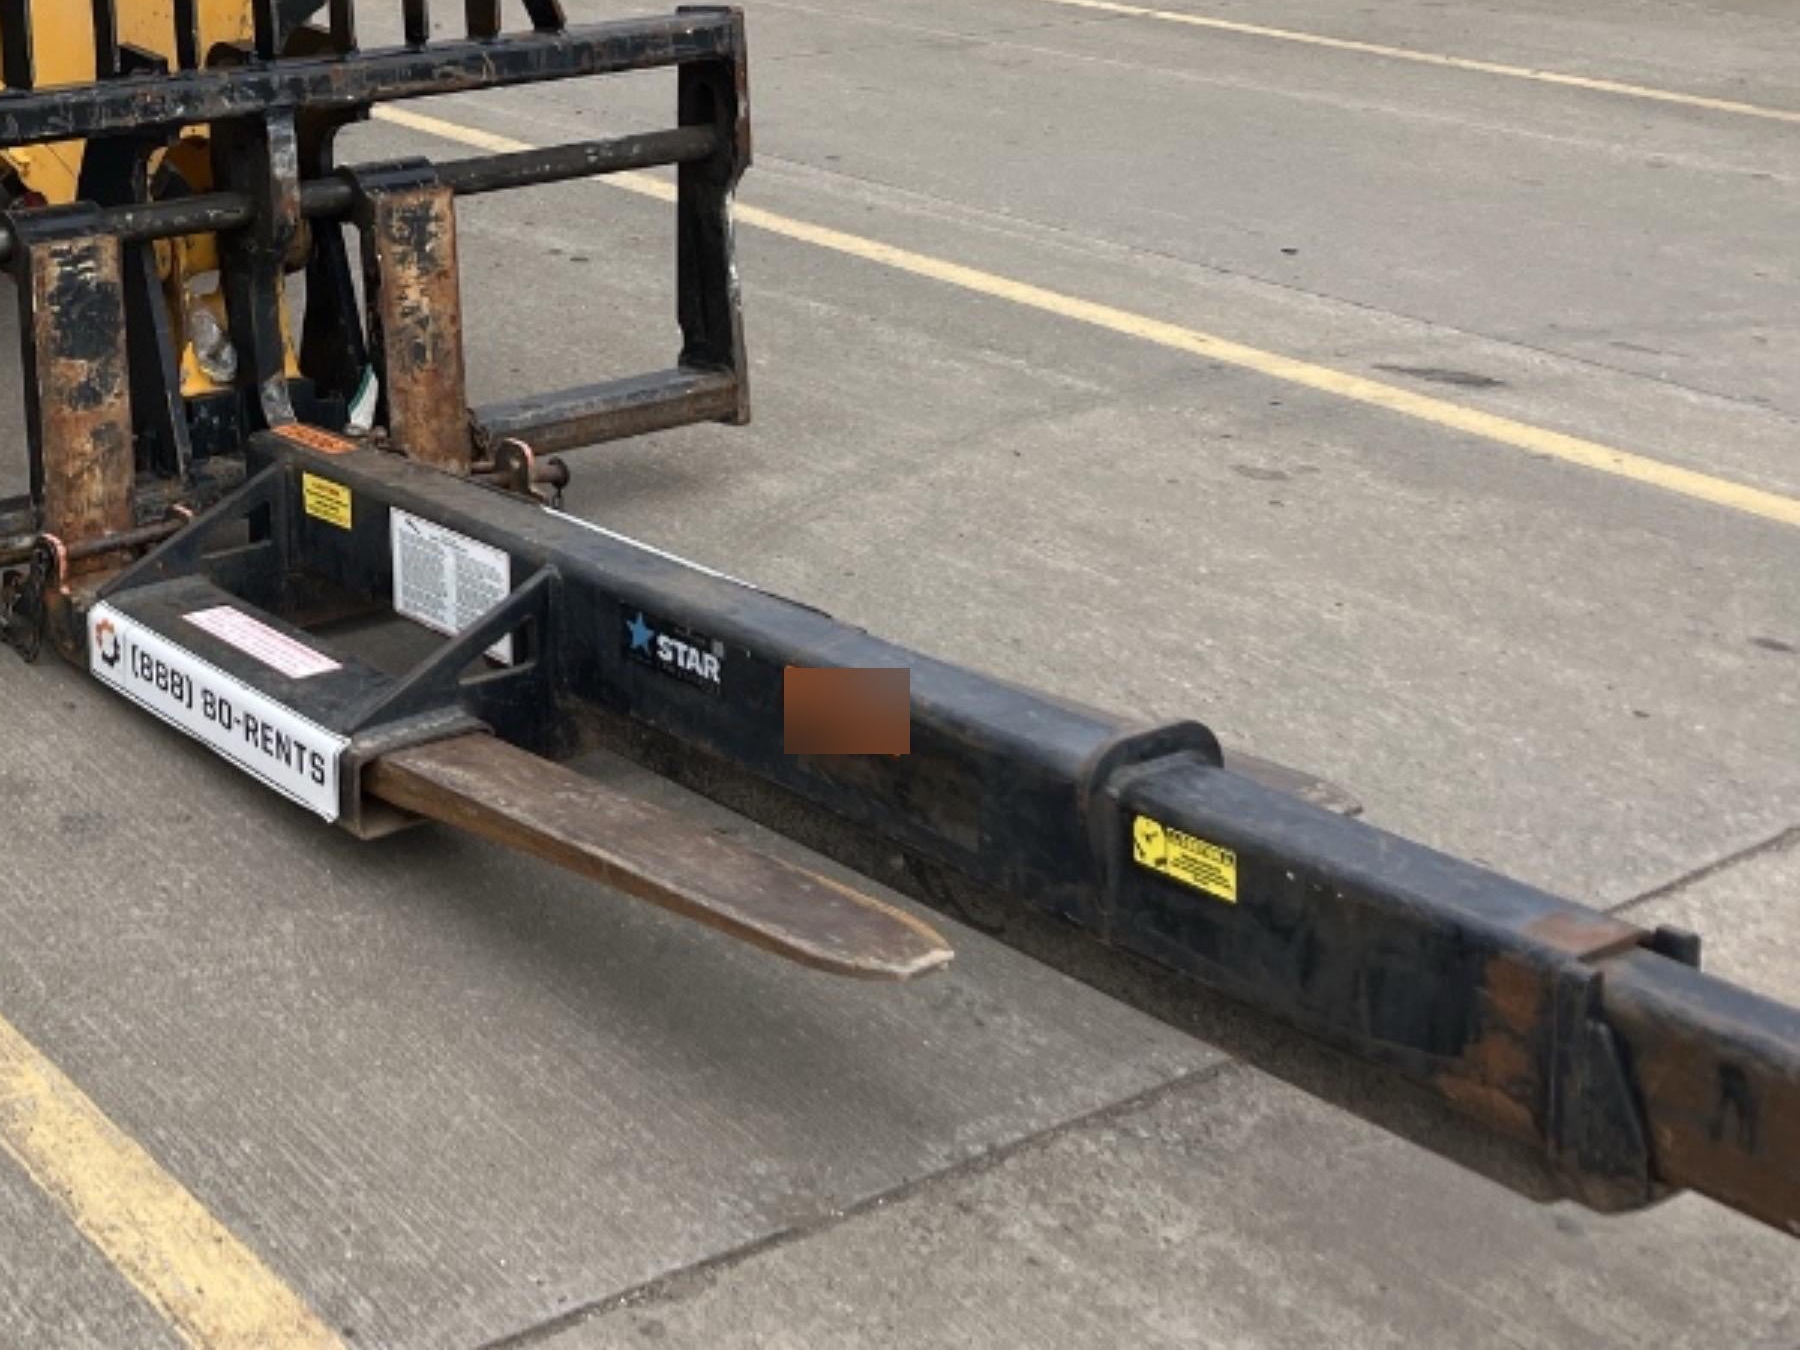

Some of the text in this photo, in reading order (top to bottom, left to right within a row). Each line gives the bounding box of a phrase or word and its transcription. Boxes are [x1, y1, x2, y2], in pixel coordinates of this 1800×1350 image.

[656, 634, 721, 685] STAR
[131, 644, 325, 786] (888) 80-RENTS
